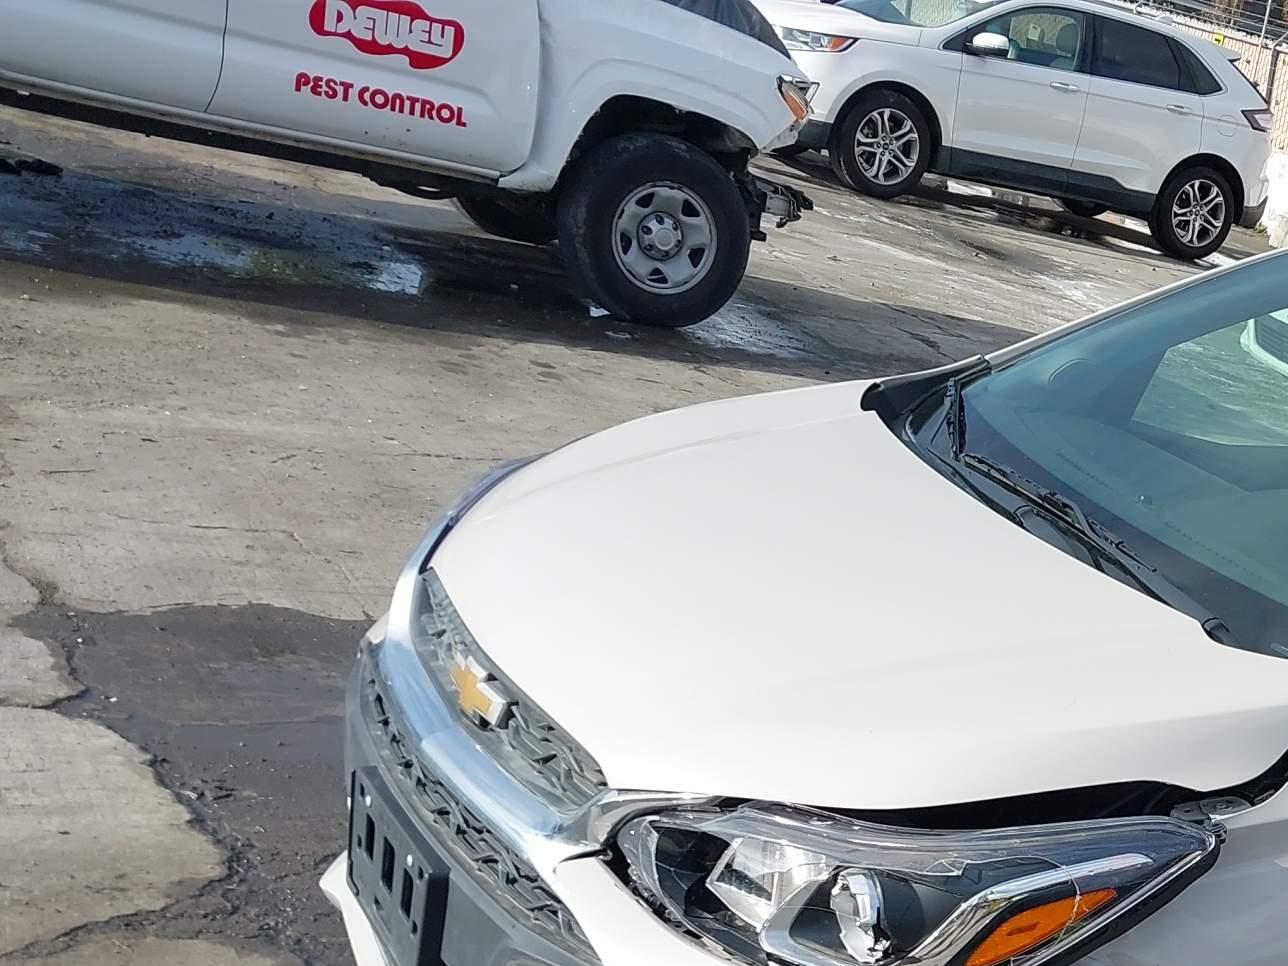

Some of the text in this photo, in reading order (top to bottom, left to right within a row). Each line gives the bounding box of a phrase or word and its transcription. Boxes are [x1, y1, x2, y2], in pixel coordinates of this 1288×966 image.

[323, 0, 455, 58] DEWEY
[294, 72, 467, 128] PEST CONTROL
